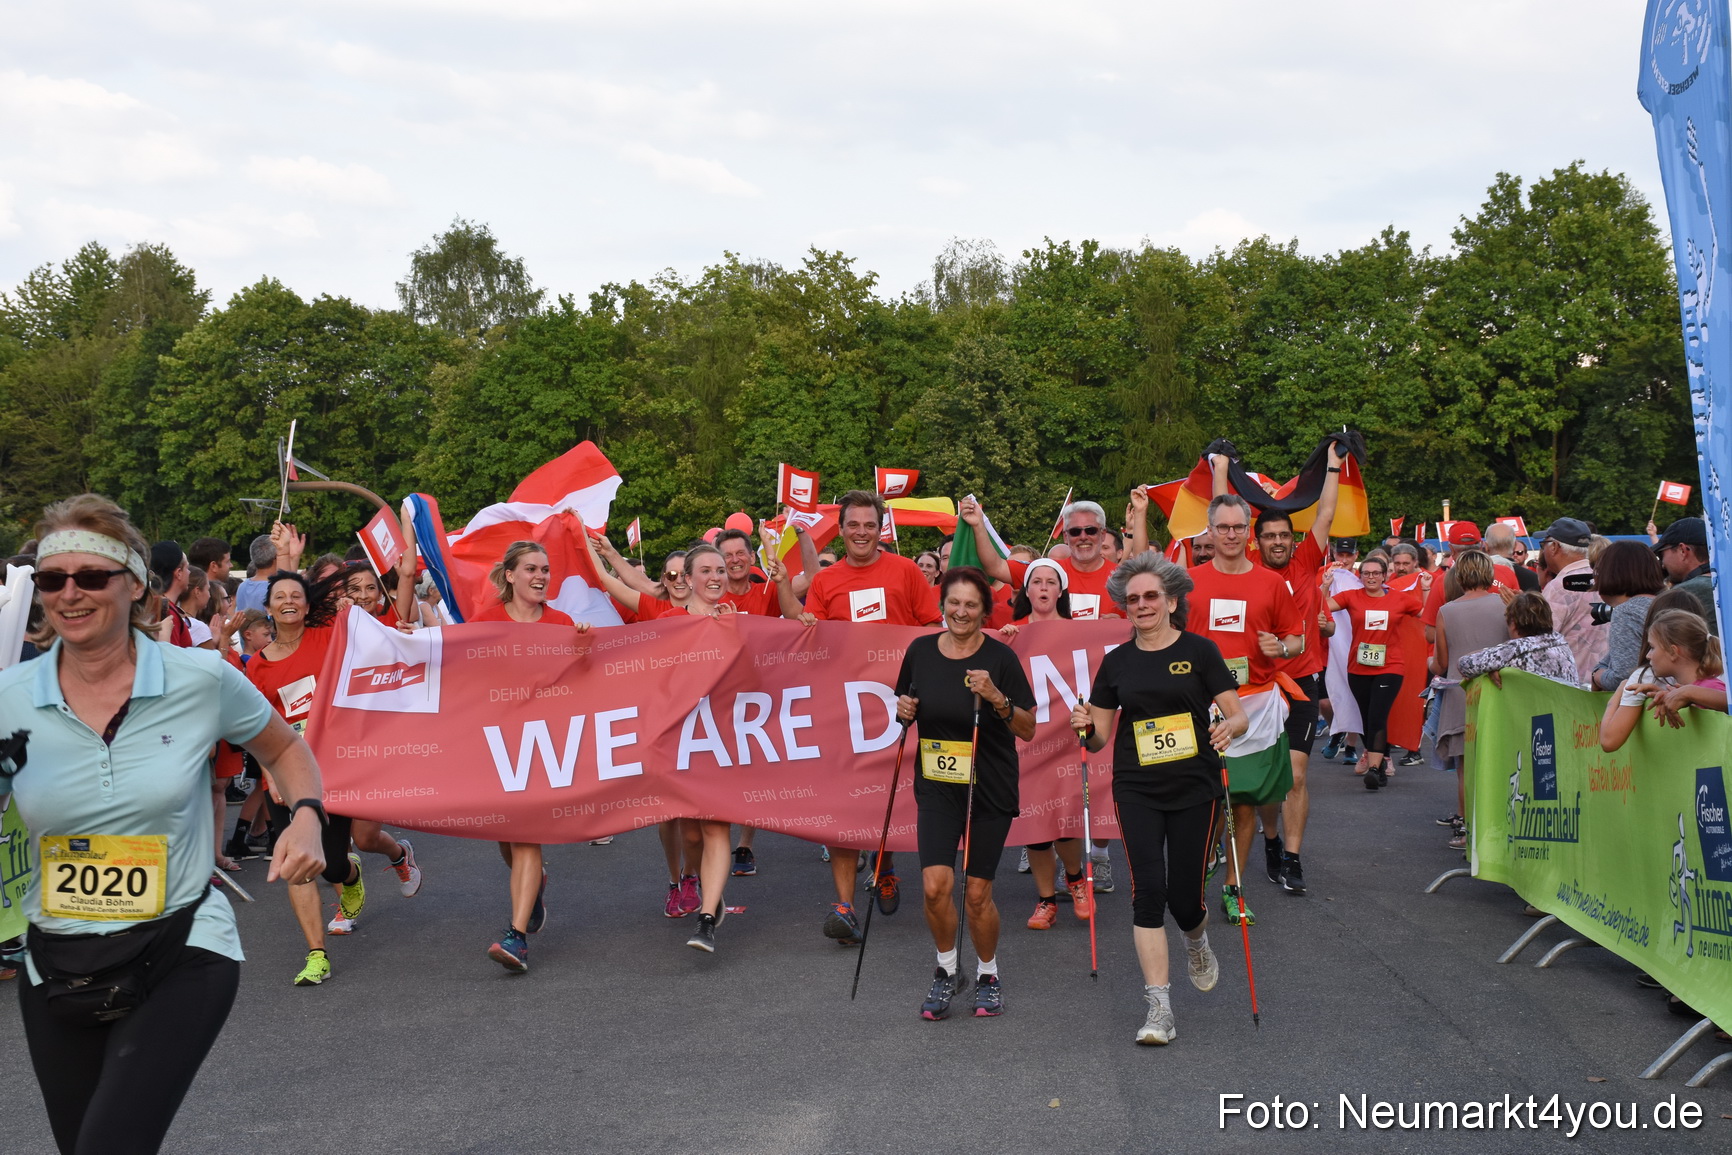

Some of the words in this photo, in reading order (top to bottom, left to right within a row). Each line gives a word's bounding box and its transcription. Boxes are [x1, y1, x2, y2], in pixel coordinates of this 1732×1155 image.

[466, 645, 508, 659] DEHN
[513, 644, 522, 656] E
[526, 643, 592, 657] shireletsa
[597, 629, 662, 652] setshaba.
[605, 658, 645, 676] DEHN
[650, 647, 725, 670] beschermt.
[763, 651, 785, 667] DEHN
[788, 646, 830, 664] megvéd.
[867, 649, 907, 663] DEHN
[1363, 651, 1380, 660] 518
[371, 669, 405, 686] DEHN
[489, 686, 530, 702] DEHN
[535, 683, 574, 699] aabo.
[483, 706, 644, 792] WE
[676, 685, 820, 770] ARE
[1154, 732, 1177, 750] 56
[336, 745, 378, 759] DEHN
[384, 743, 443, 759] protege.
[1536, 741, 1552, 757] Fischer
[937, 755, 957, 771] 62
[321, 790, 360, 803] DEHN
[366, 786, 439, 800] chireletsa.
[743, 789, 777, 803] DEHN
[779, 785, 818, 800] chrání.
[552, 803, 595, 819] DEHN
[601, 794, 664, 814] protects.
[1013, 797, 1069, 819] eskytter.
[1700, 803, 1724, 822] Fischer
[383, 819, 413, 827] EHN
[418, 813, 510, 828] inochengeta.
[783, 813, 837, 830] protegge.
[1519, 791, 1580, 841] firmenlauf
[838, 828, 872, 843] DEHN
[1518, 843, 1549, 860] neumarkt
[56, 863, 148, 897] 2020
[70, 896, 103, 906] Claudia
[106, 898, 134, 907] Böhm
[1698, 937, 1732, 961] neumark
